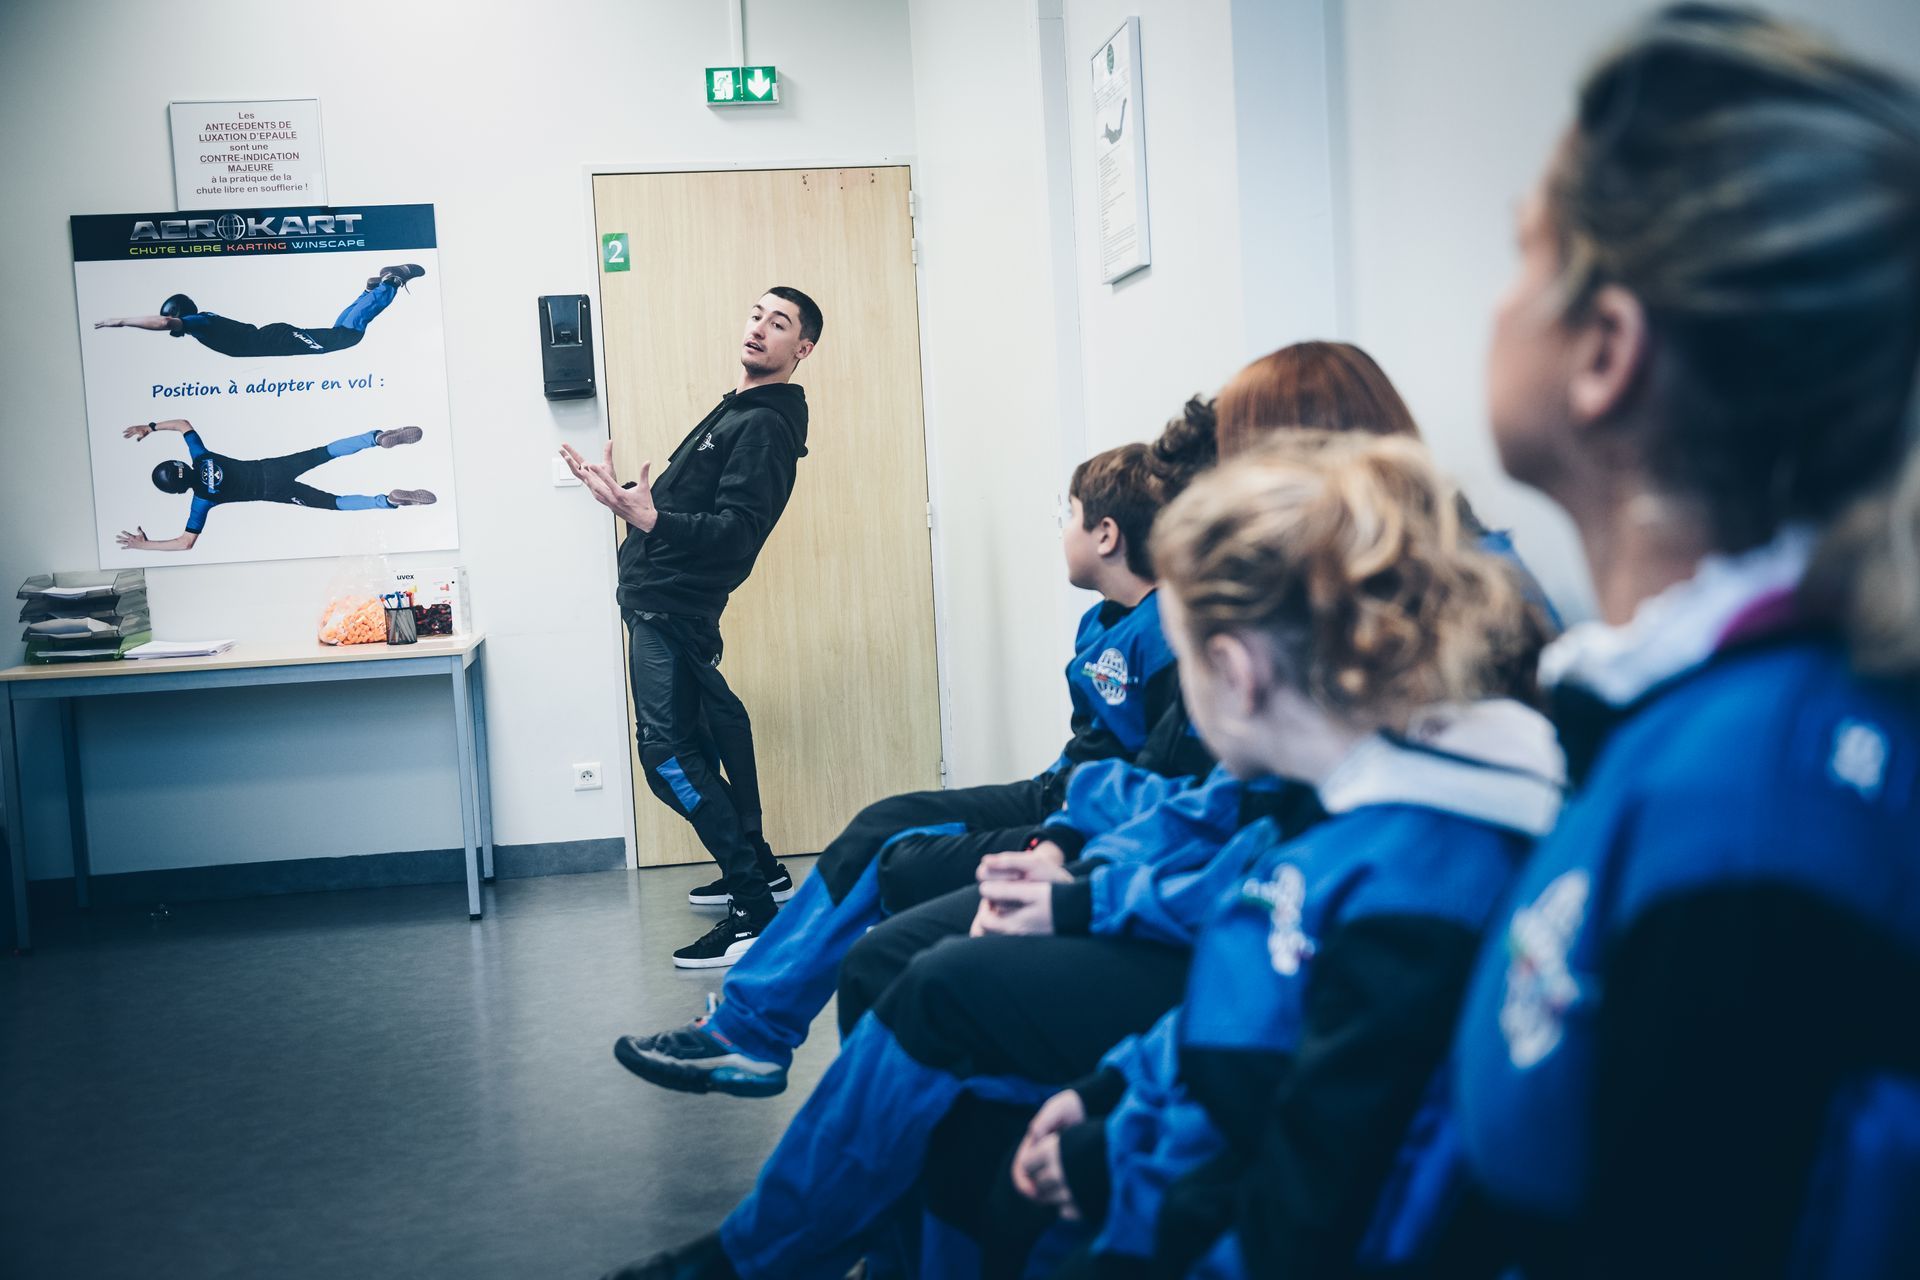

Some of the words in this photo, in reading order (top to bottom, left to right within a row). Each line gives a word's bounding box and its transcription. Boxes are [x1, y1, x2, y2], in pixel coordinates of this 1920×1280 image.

[238, 112, 255, 120] Les
[205, 122, 277, 131] ANTECEDENTS
[279, 121, 292, 129] DE
[199, 132, 248, 142] LUXATION
[250, 131, 297, 140] D'EPAULE
[200, 152, 300, 163] CONTRE-INDICATION
[227, 164, 274, 172] MAJEURE
[211, 175, 217, 183] à
[219, 175, 228, 183] la
[229, 175, 268, 185] pratique
[269, 174, 282, 182] de
[196, 186, 222, 195] chute
[224, 185, 245, 193] libre
[260, 183, 303, 192] soufflerie
[129, 212, 363, 242] AEROKART
[129, 245, 177, 255] CHUTE
[181, 243, 222, 253] LIBRE
[226, 242, 287, 251] KARTING
[291, 239, 366, 249] WINSCAPE
[608, 240, 625, 263] 2
[152, 382, 221, 398] Position
[228, 379, 239, 395] à
[245, 376, 315, 397] adopter
[321, 378, 342, 391] en
[348, 374, 374, 390] vol
